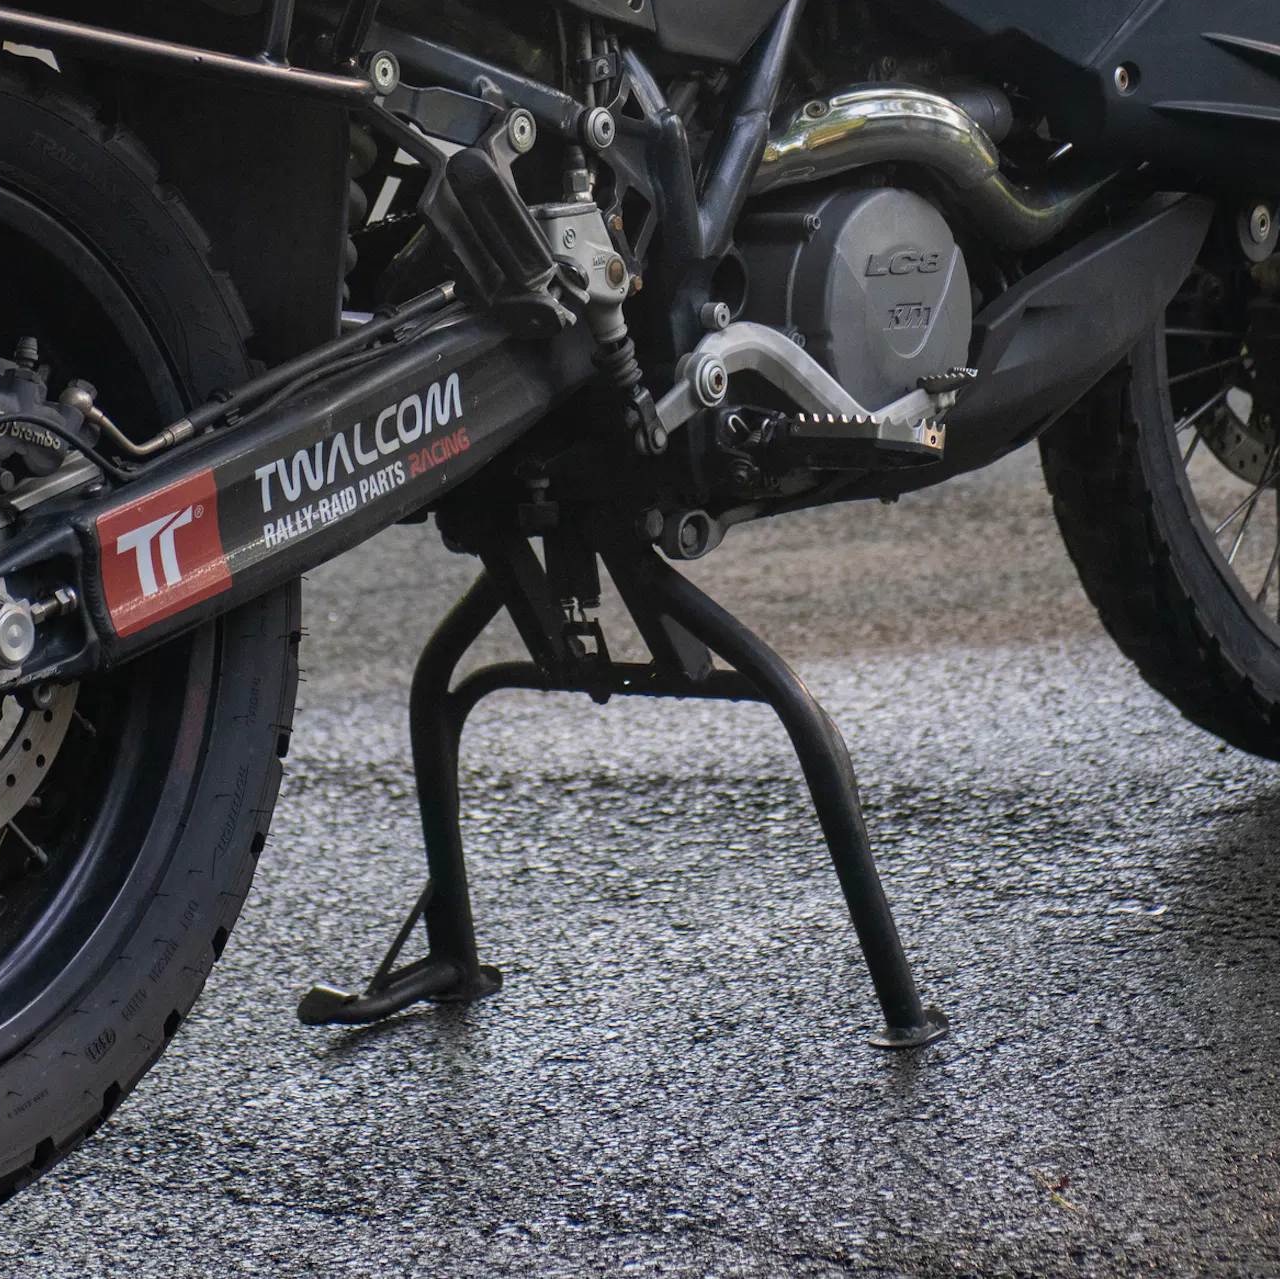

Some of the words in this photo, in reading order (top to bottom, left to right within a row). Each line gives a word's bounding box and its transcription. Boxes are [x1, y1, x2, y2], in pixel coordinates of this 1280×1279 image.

[864, 247, 942, 277] LC8
[11, 421, 61, 450] brembo
[255, 372, 463, 513] TWALCOM
[263, 485, 358, 549] RALLY-RAID
[359, 460, 405, 505] PARTS
[408, 427, 471, 478] RACING
